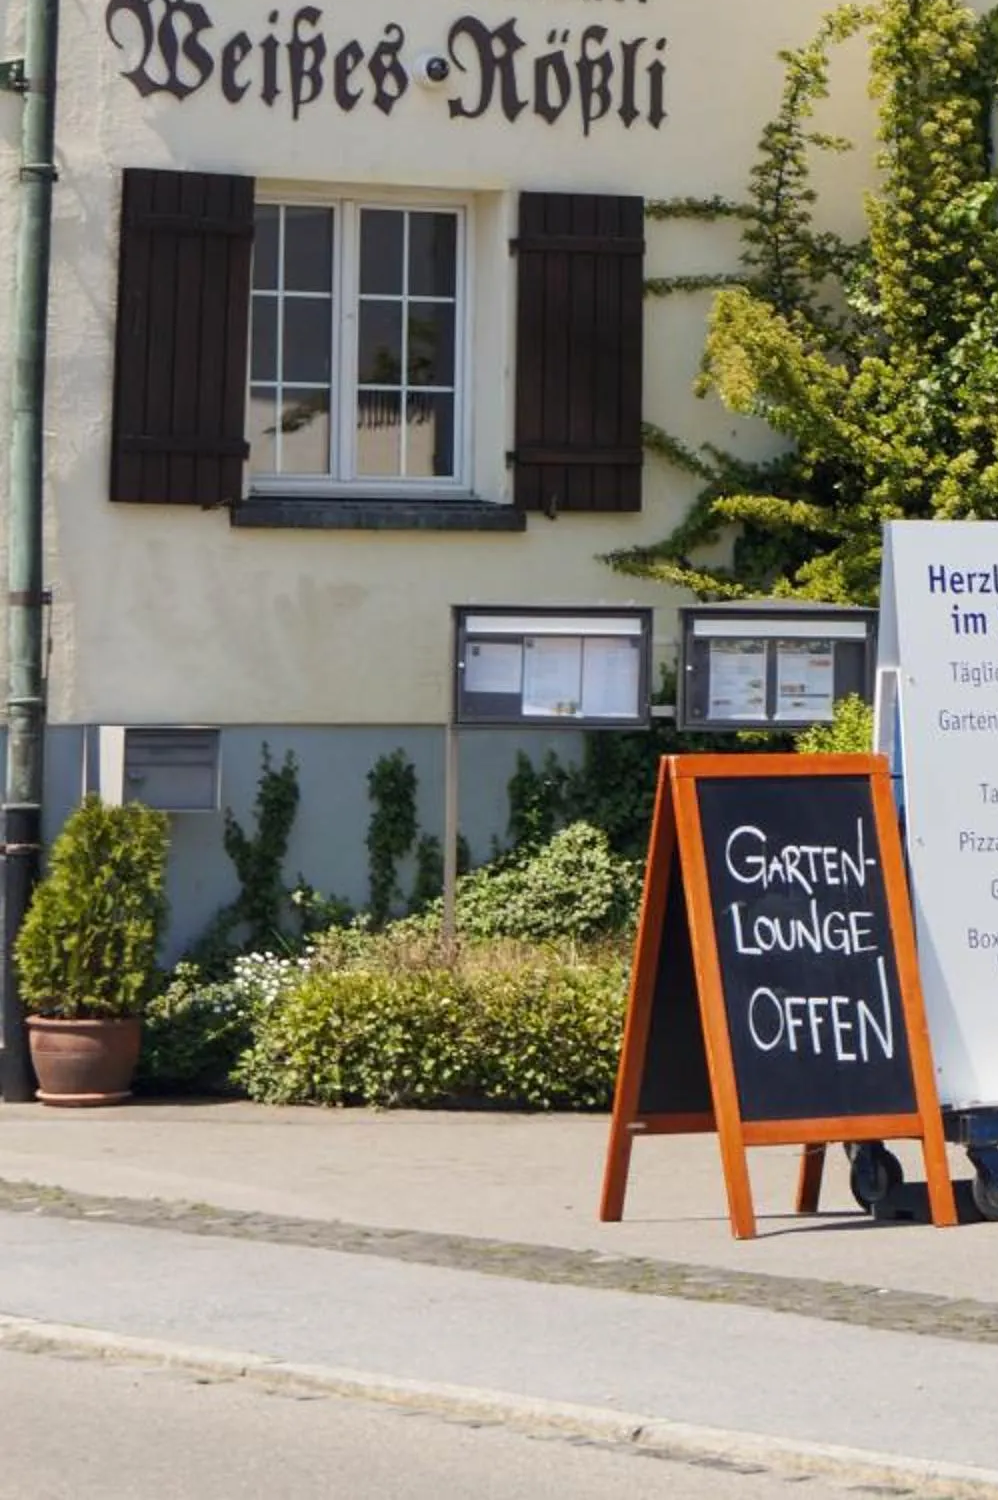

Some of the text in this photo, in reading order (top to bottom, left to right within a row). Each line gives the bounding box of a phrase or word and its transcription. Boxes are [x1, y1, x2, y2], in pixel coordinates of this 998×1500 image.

[951, 605, 987, 635] im
[725, 817, 875, 894] GARTEN-
[731, 899, 878, 955] LOUNGE
[749, 956, 893, 1062] OFFEN
